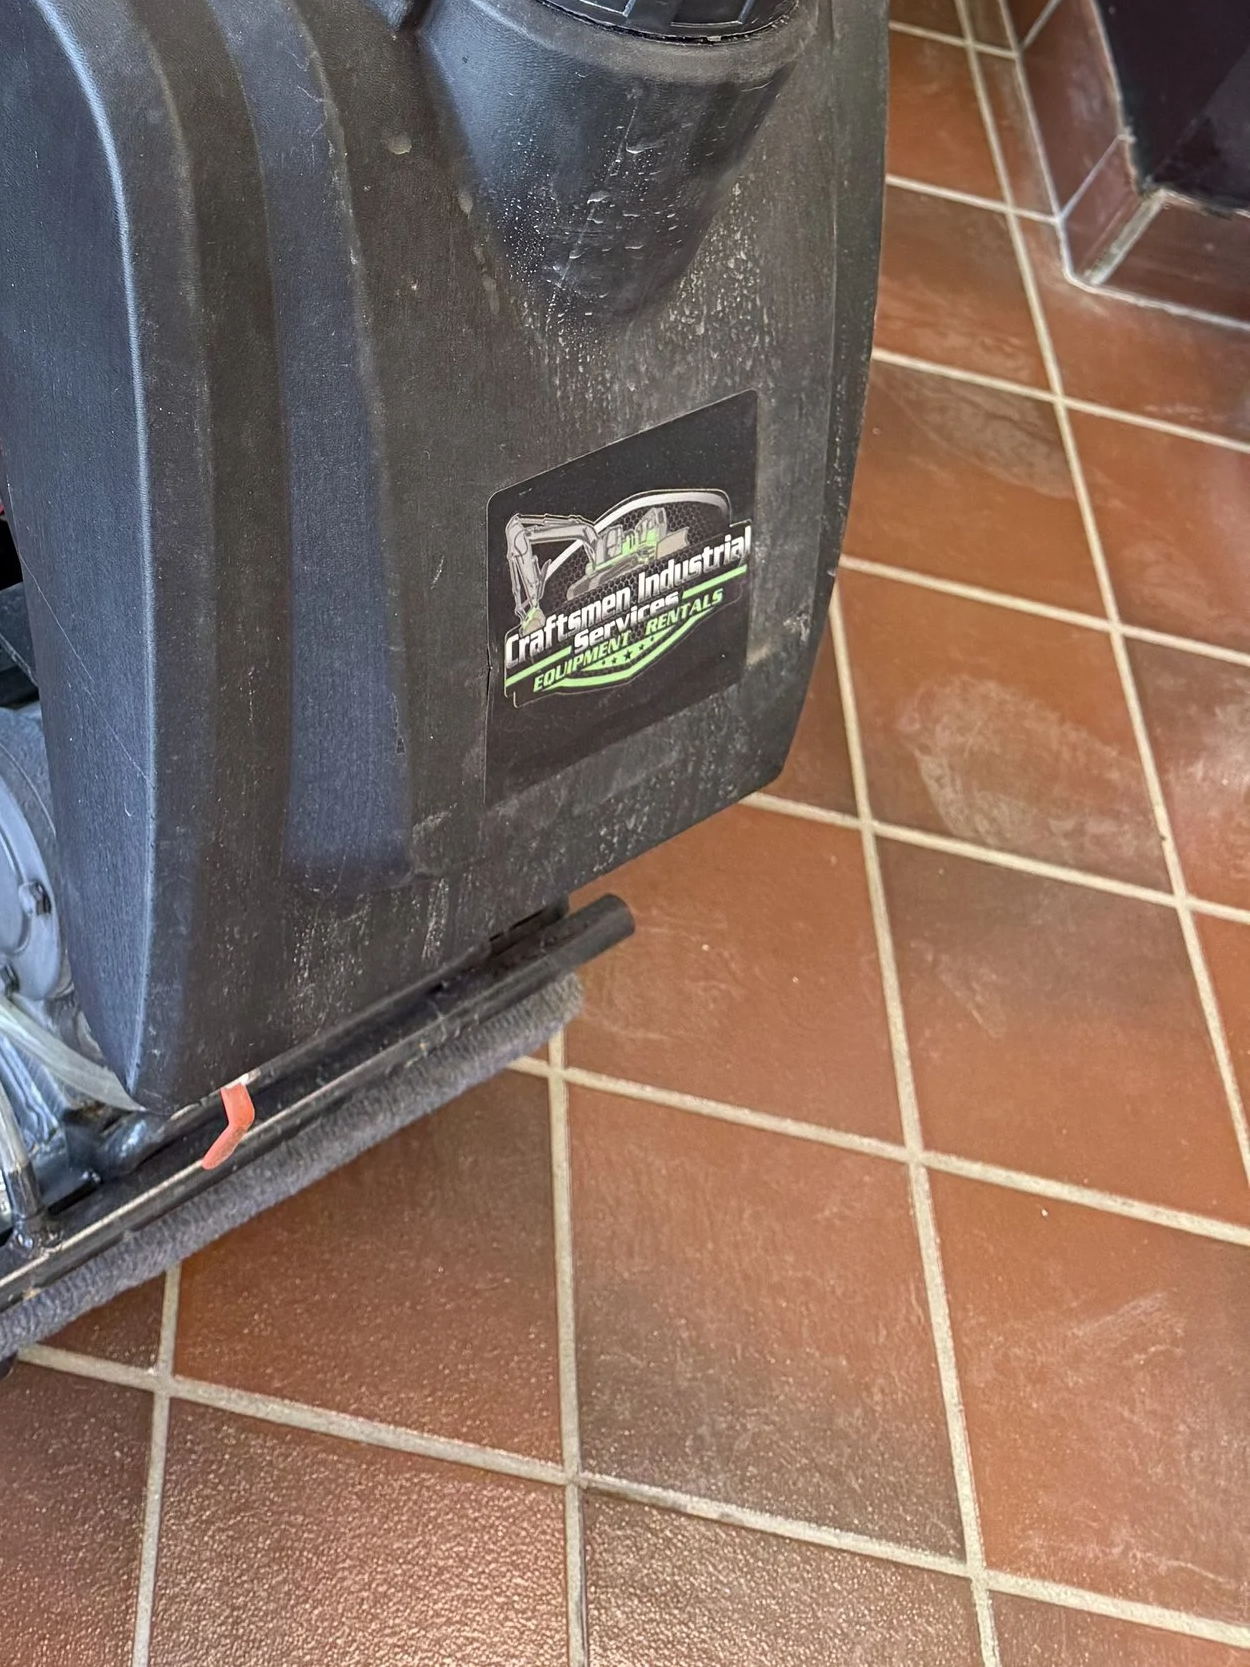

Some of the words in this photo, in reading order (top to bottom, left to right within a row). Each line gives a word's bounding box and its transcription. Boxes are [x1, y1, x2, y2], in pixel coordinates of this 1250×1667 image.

[505, 586, 631, 670] Craftsmen
[637, 525, 751, 598] Industrial
[532, 630, 633, 693] EQUIPMENT
[645, 587, 724, 636] RENTALS
[573, 590, 680, 654] Services
